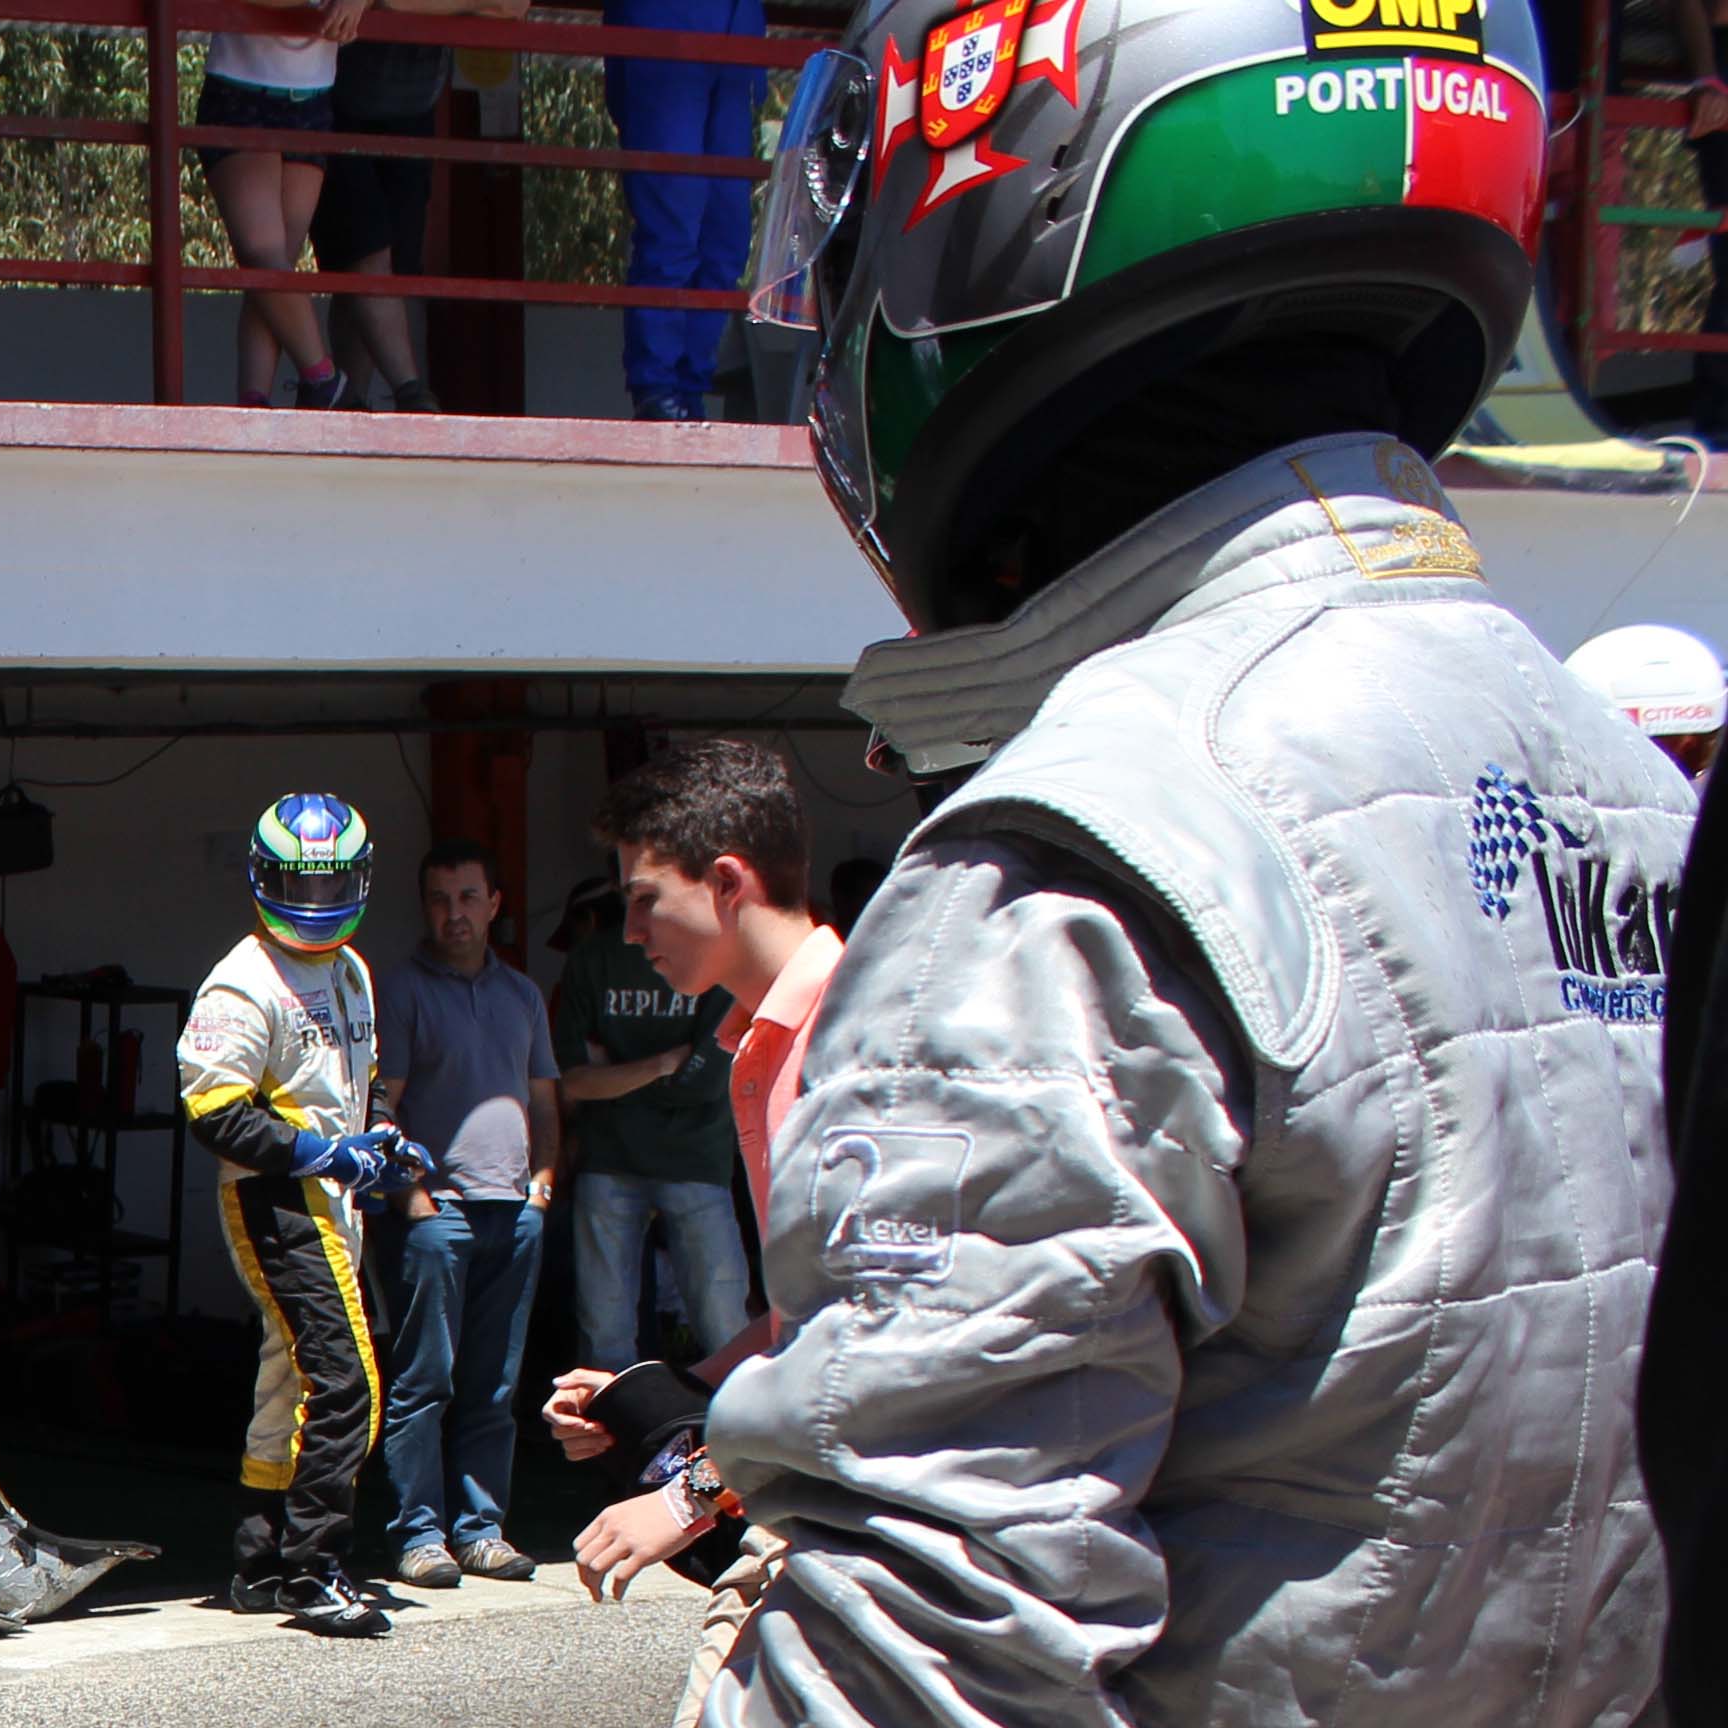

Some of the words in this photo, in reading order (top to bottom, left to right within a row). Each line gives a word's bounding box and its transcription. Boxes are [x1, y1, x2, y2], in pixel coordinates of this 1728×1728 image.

[1275, 67, 1508, 123] PORTUGAL
[279, 860, 352, 872] HERBALIFE
[604, 988, 699, 1017] REPLAY
[857, 1211, 940, 1243] Level
